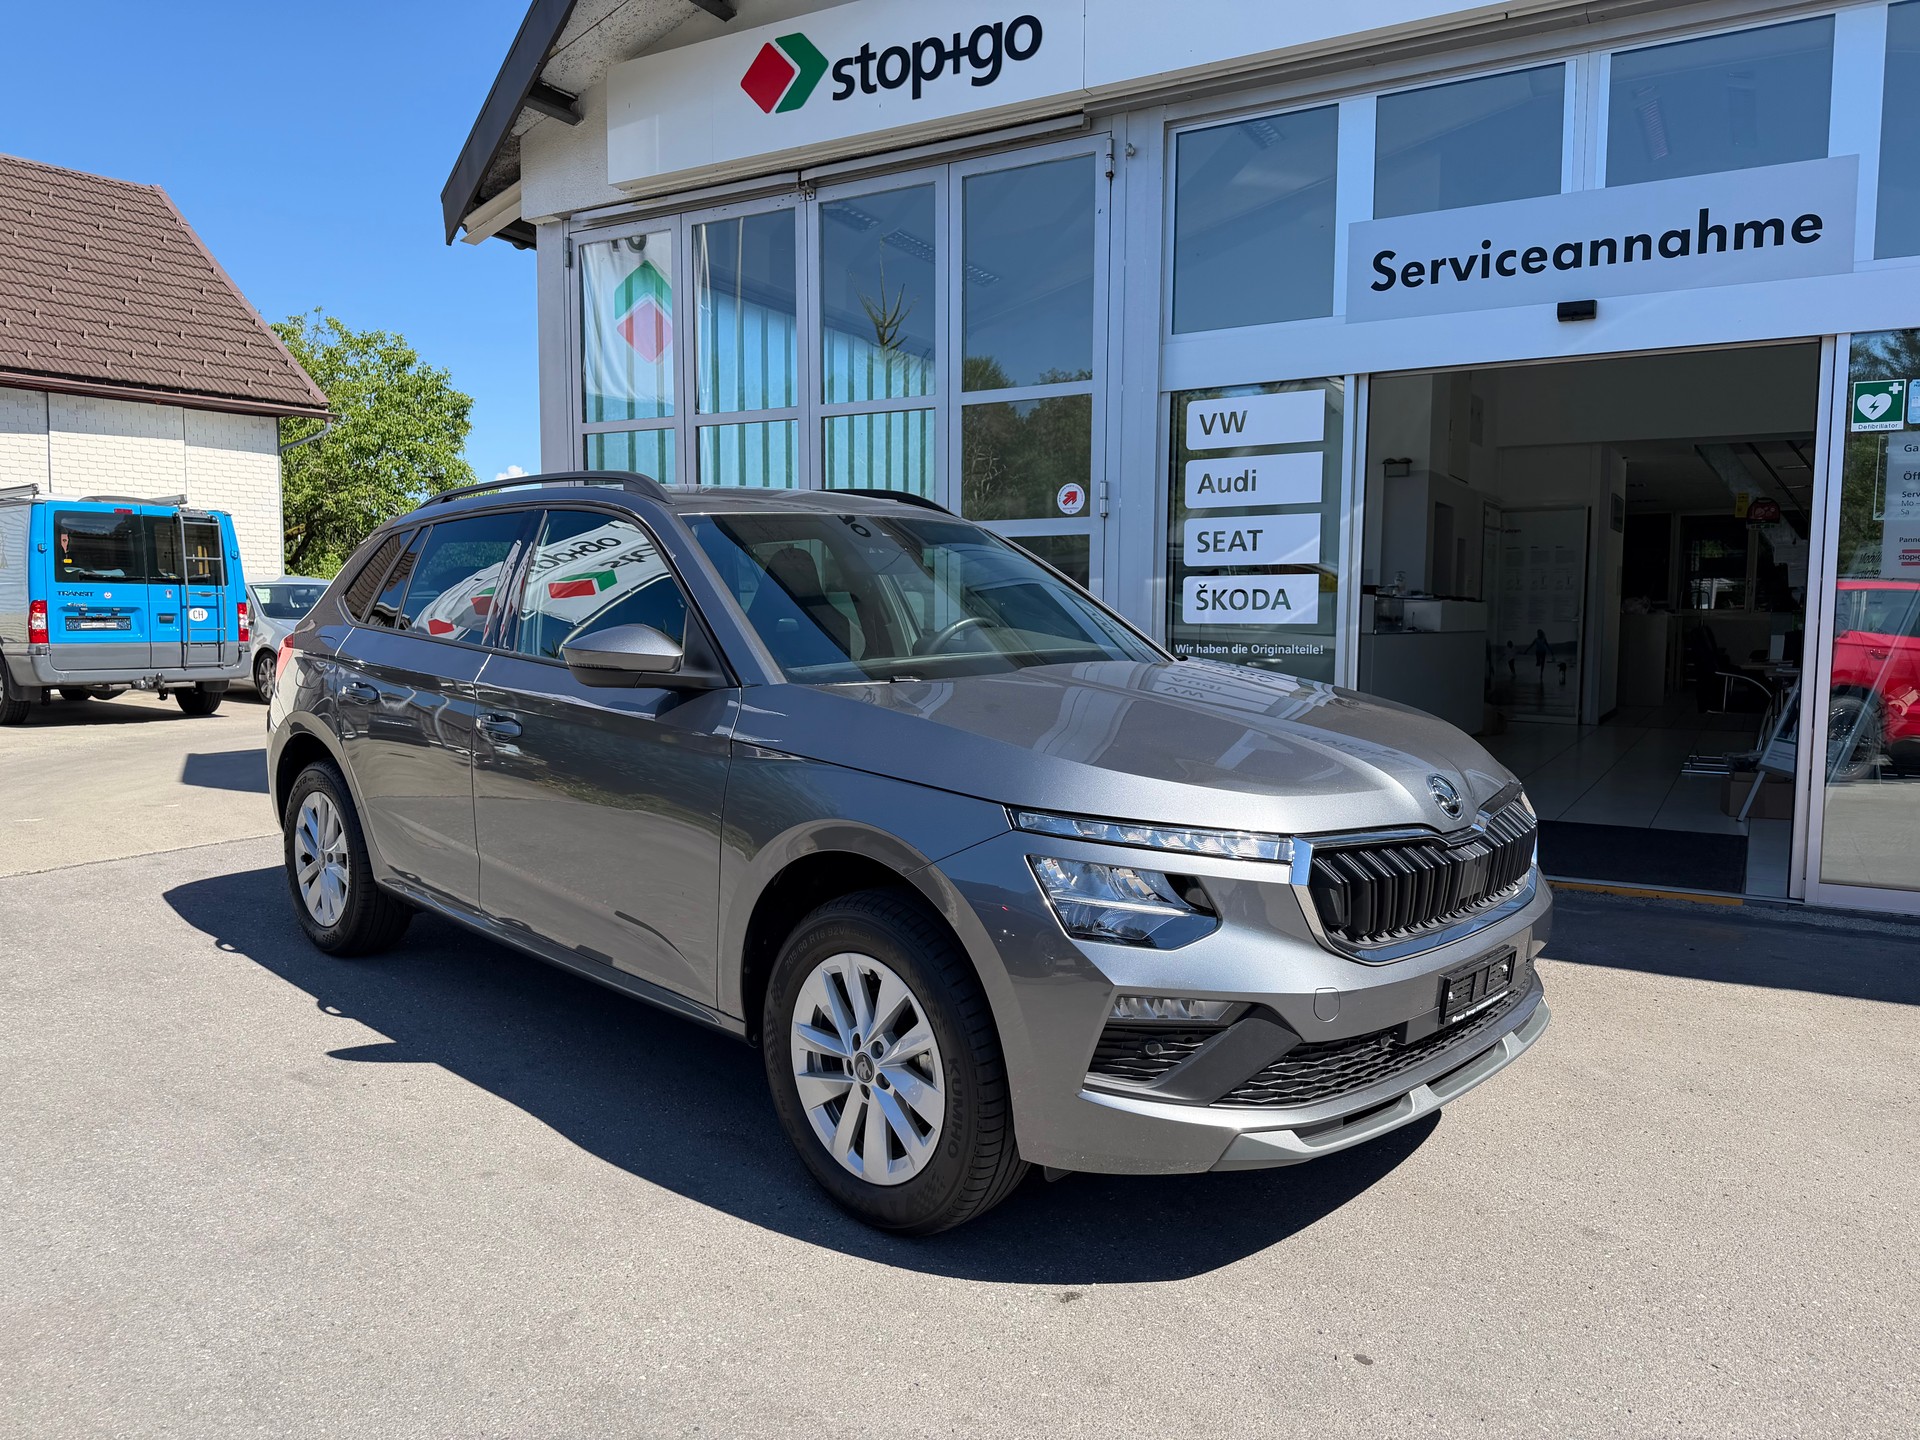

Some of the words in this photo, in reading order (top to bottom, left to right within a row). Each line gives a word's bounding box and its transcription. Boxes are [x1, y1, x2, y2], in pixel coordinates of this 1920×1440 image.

[832, 14, 1043, 101] stop+go
[1370, 207, 1823, 292] Serviceannahme
[1199, 410, 1248, 435] VW
[1197, 469, 1257, 494] Audi
[1197, 529, 1263, 553] SEAT
[1196, 583, 1292, 611] ŠKODA
[192, 609, 204, 619] CH
[1175, 643, 1194, 653] Wir
[1196, 644, 1229, 654] haben
[1231, 644, 1248, 654] die
[1251, 644, 1324, 656] Originalteile!
[947, 1058, 963, 1159] KUMHO
